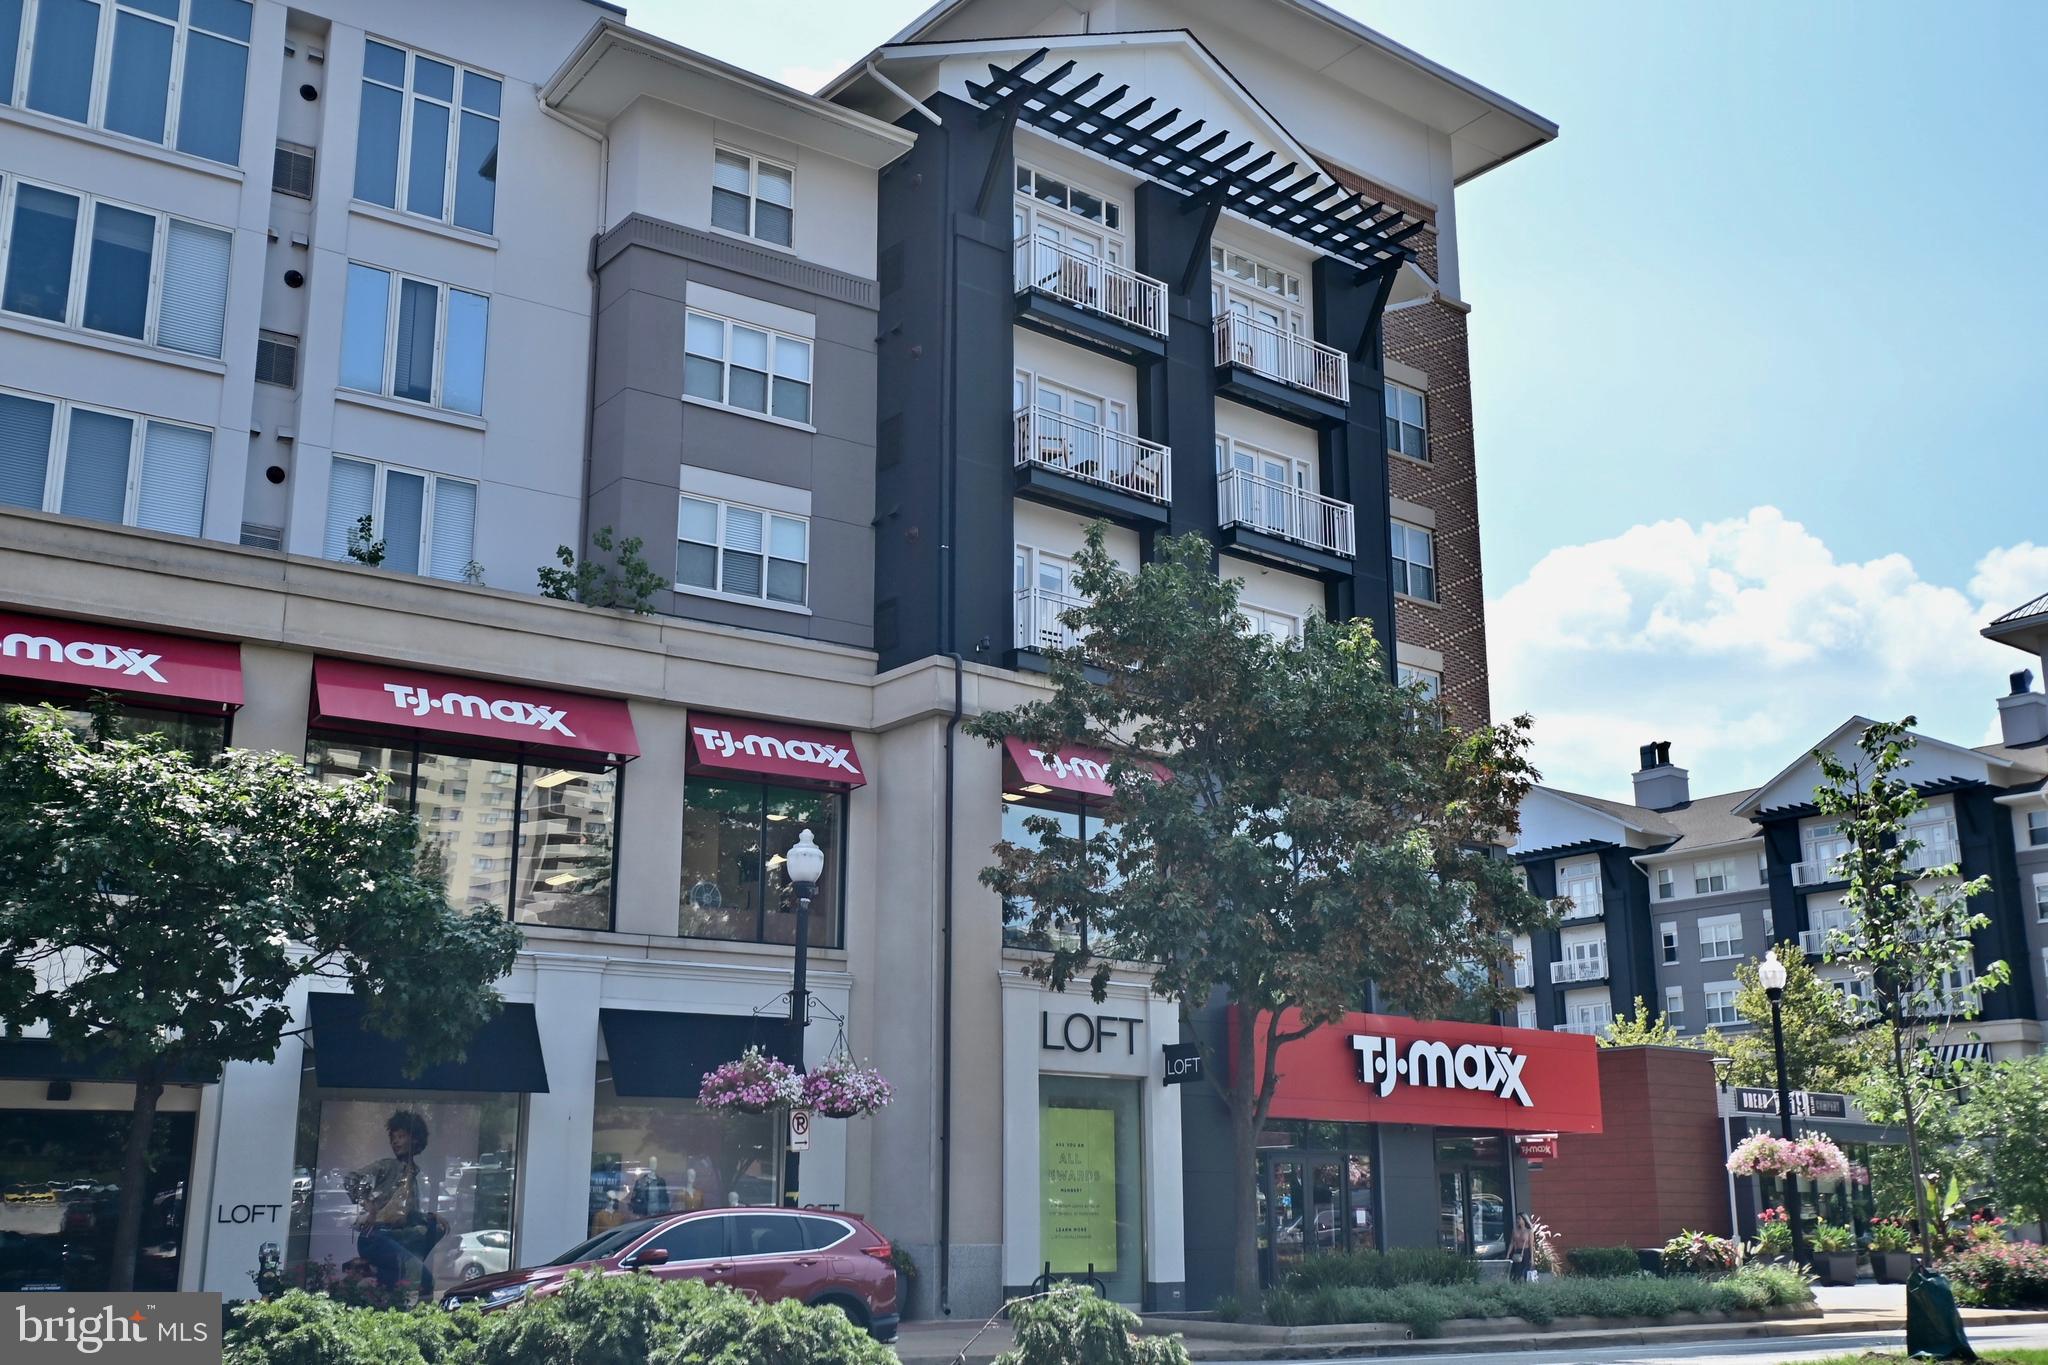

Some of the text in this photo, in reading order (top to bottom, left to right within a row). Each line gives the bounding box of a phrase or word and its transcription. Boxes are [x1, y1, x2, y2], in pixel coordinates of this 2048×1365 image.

[0, 633, 168, 683] maxx
[1042, 1011, 1144, 1055] LOFT
[1167, 1057, 1200, 1075] LOFT
[1058, 1152, 1082, 1165] ALL
[218, 1204, 283, 1223] LOFT
